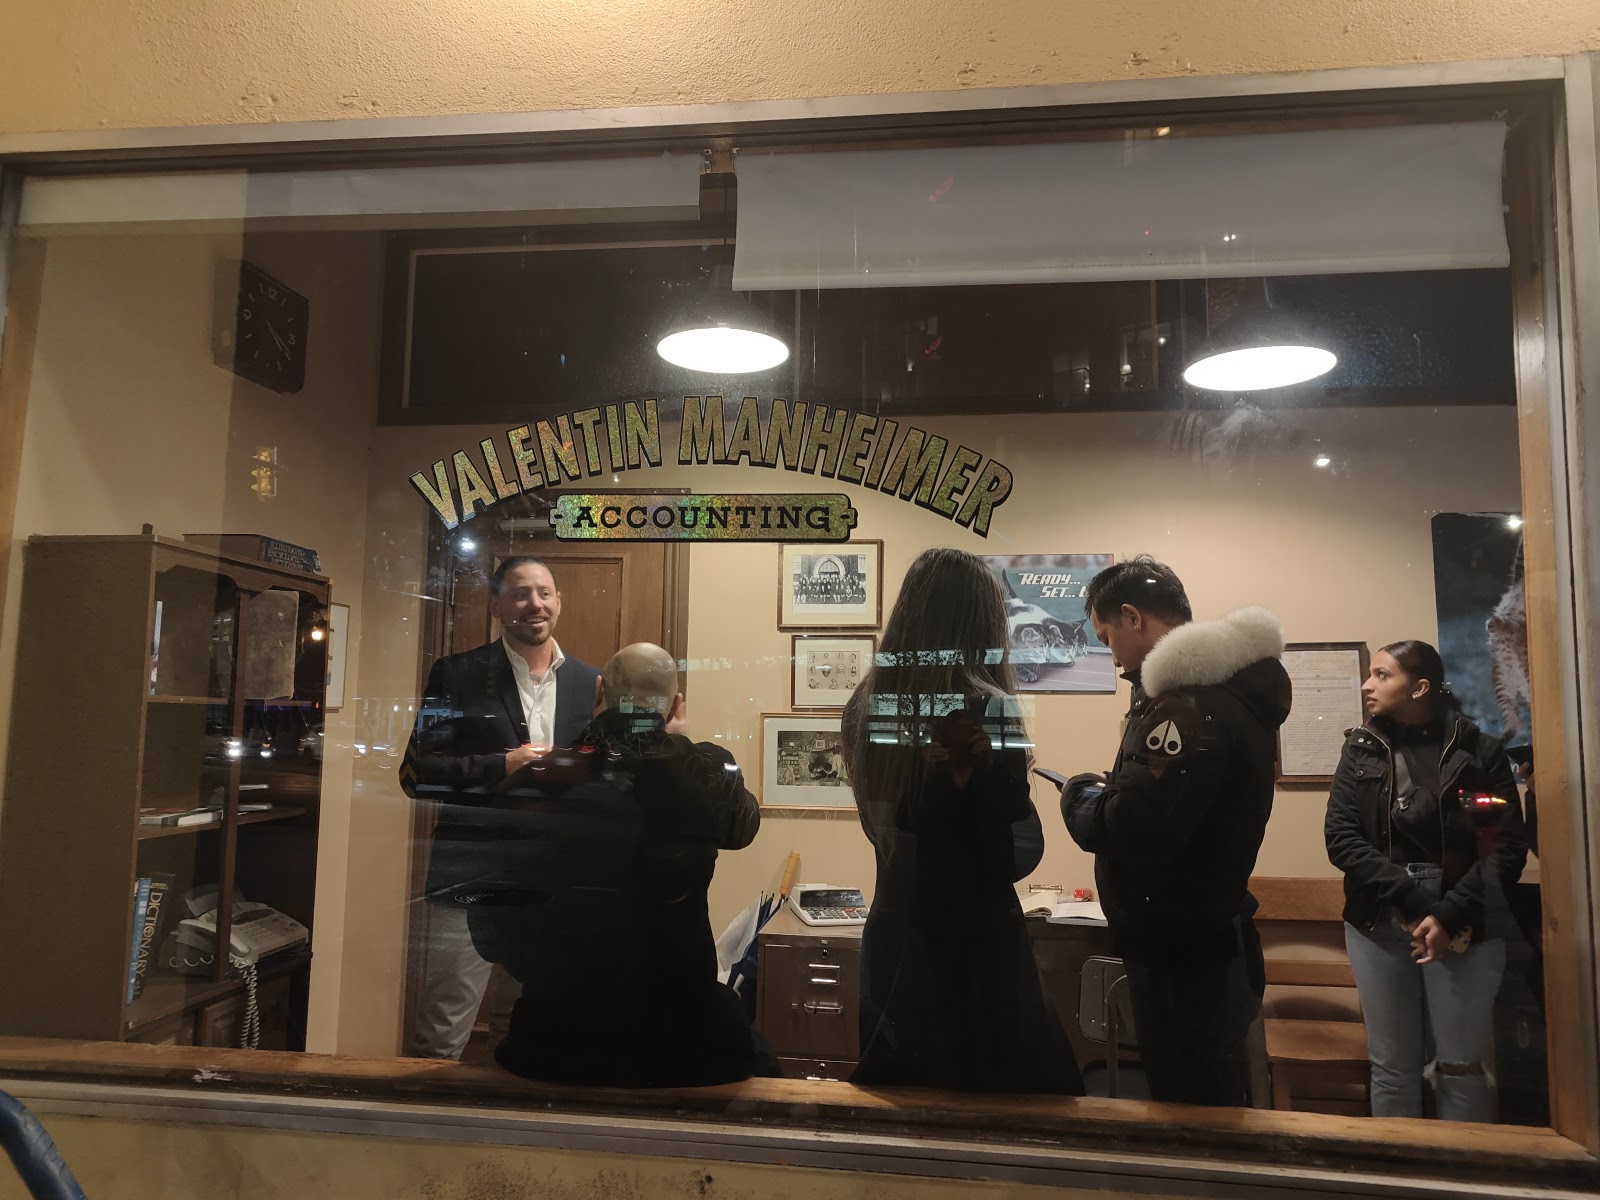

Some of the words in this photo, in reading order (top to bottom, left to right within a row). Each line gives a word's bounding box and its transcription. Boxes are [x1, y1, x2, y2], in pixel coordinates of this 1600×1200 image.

[409, 397, 662, 530] VALENTIN
[678, 395, 1014, 539] MANHEIMER
[573, 506, 831, 533] ACCOUNTING
[136, 892, 162, 977] DICTIONARY
